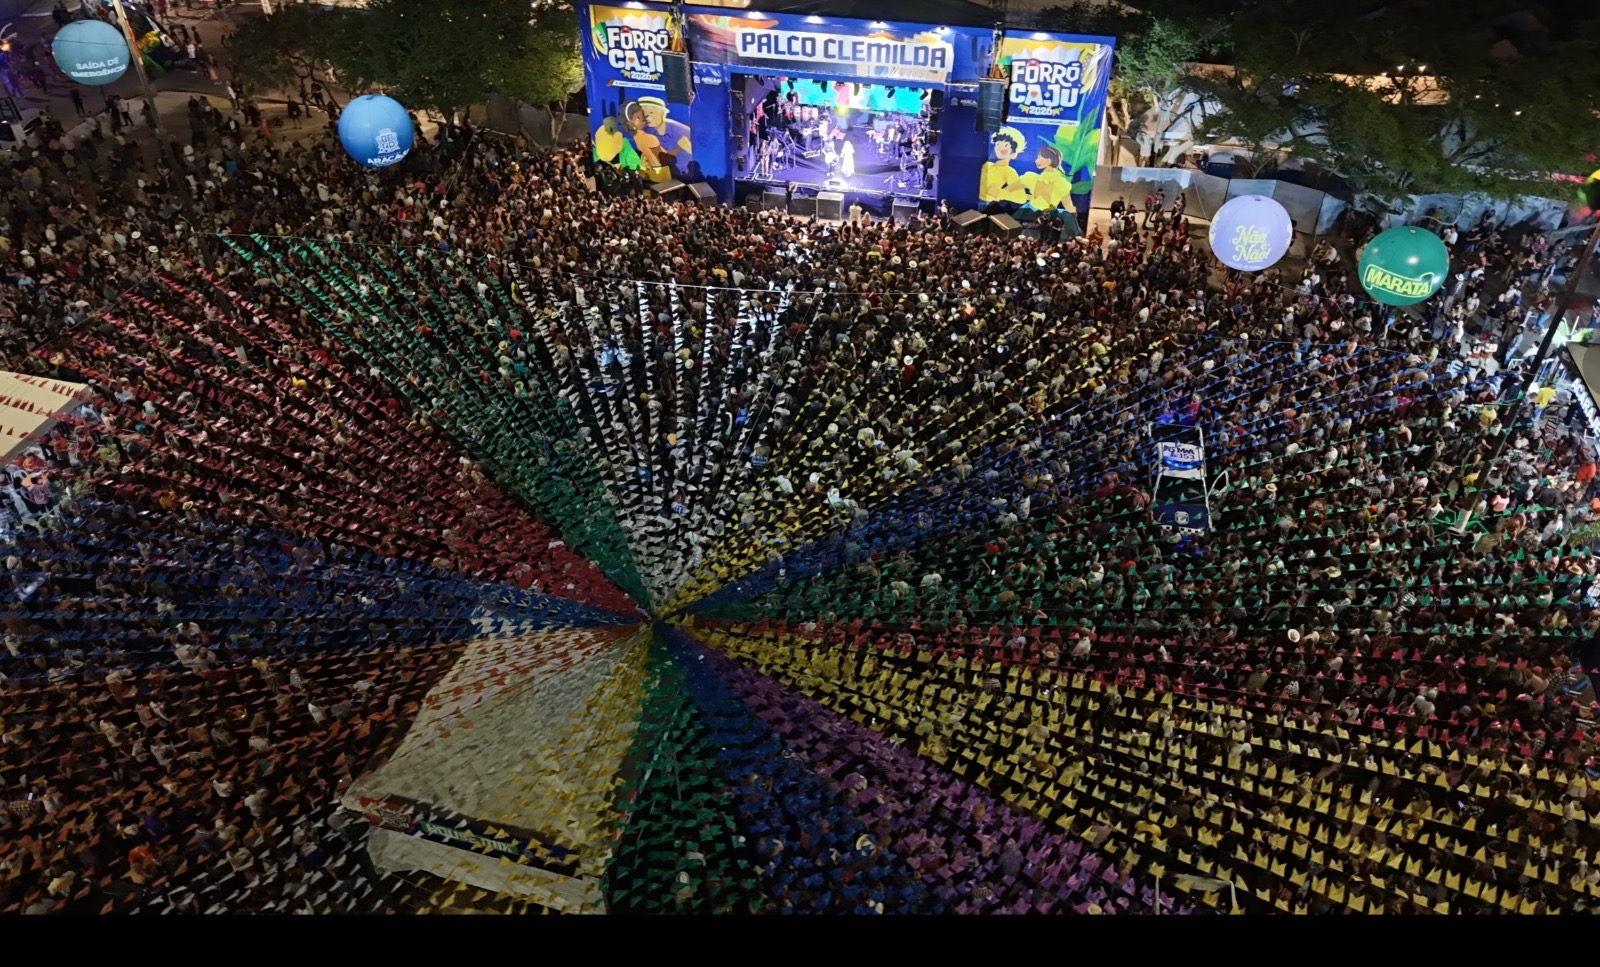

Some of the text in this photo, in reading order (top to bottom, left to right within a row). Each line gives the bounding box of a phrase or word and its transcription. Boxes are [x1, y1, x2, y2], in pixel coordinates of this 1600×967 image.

[607, 28, 669, 53] FORRÓ
[741, 32, 946, 68] PALCO CLEMILDA
[76, 57, 120, 70] SAÍDA DE
[1012, 61, 1080, 87] FORRÓ
[630, 71, 652, 81] 2026
[1009, 83, 1079, 108] CAJU
[1029, 106, 1053, 115] 2026
[1232, 225, 1268, 245] Não
